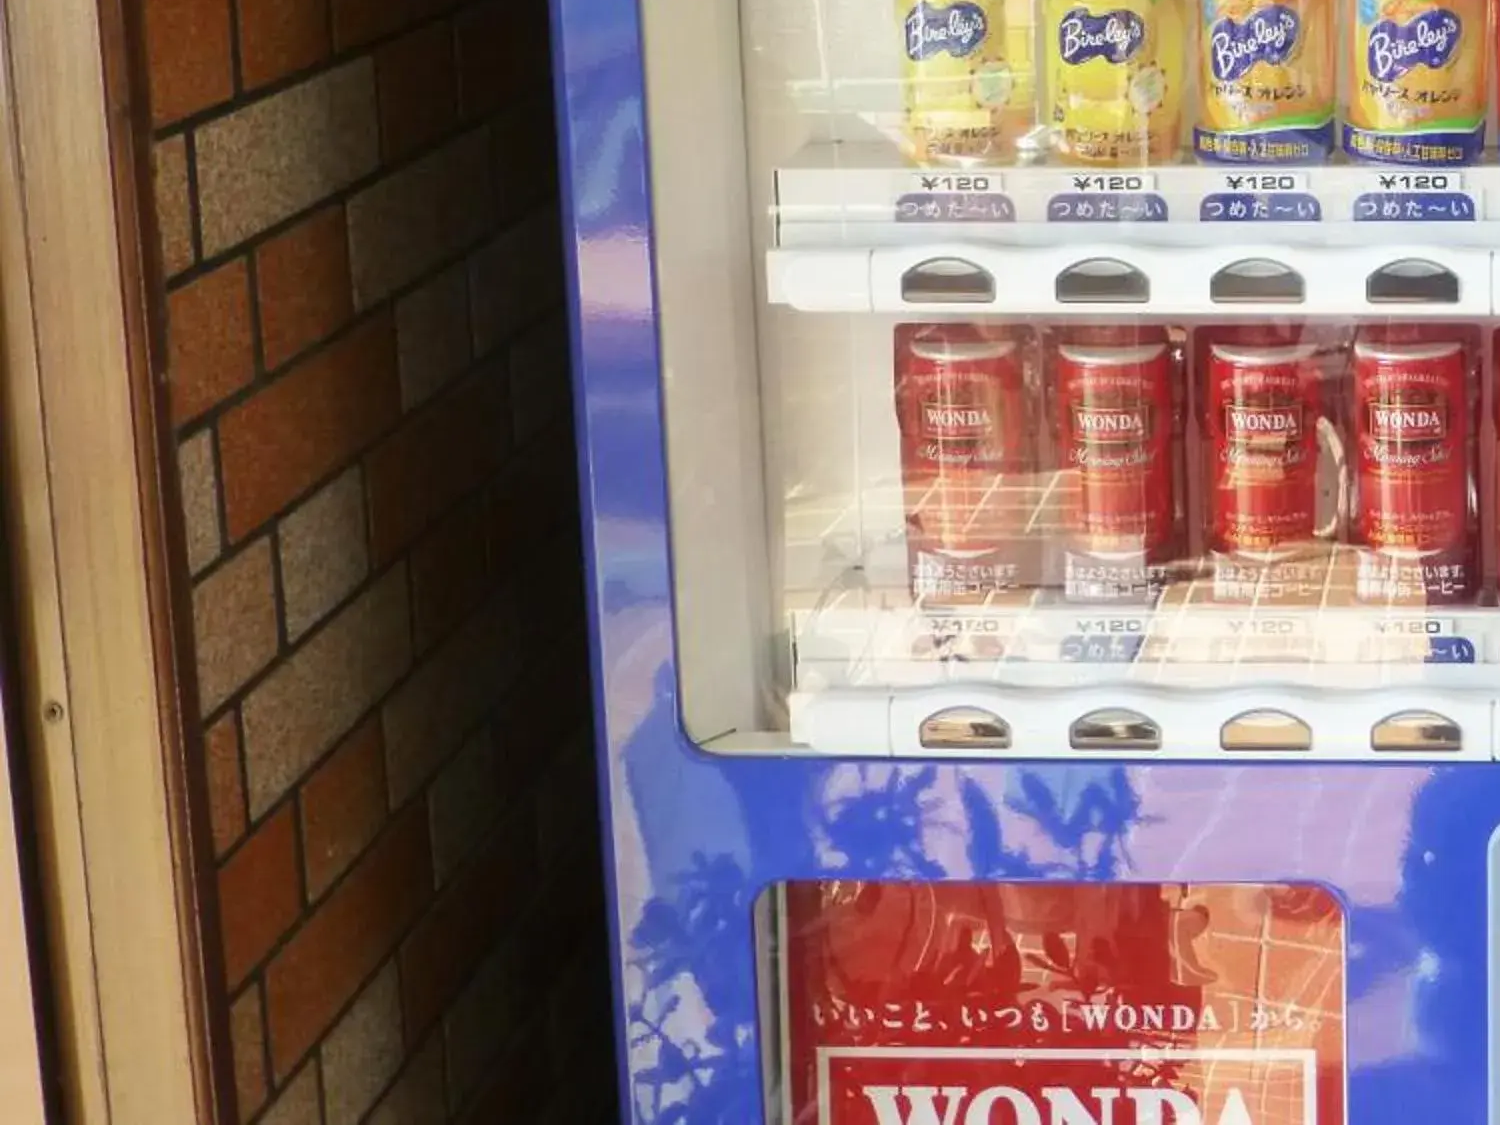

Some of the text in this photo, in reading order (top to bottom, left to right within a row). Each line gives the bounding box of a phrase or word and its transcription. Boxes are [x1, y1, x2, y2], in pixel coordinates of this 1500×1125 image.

[1061, 17, 1145, 65] Bireley's
[1213, 14, 1294, 77] Bireley's
[1370, 16, 1457, 79] Bireley's
[922, 176, 989, 191] ¥120
[1073, 176, 1142, 191] ¥120
[1226, 176, 1295, 190] ¥120
[1379, 175, 1448, 190] ¥120
[926, 408, 992, 426] WONDA
[1077, 411, 1142, 430] WONDA
[1230, 412, 1297, 432] WONDA
[1374, 410, 1439, 429] WONDA
